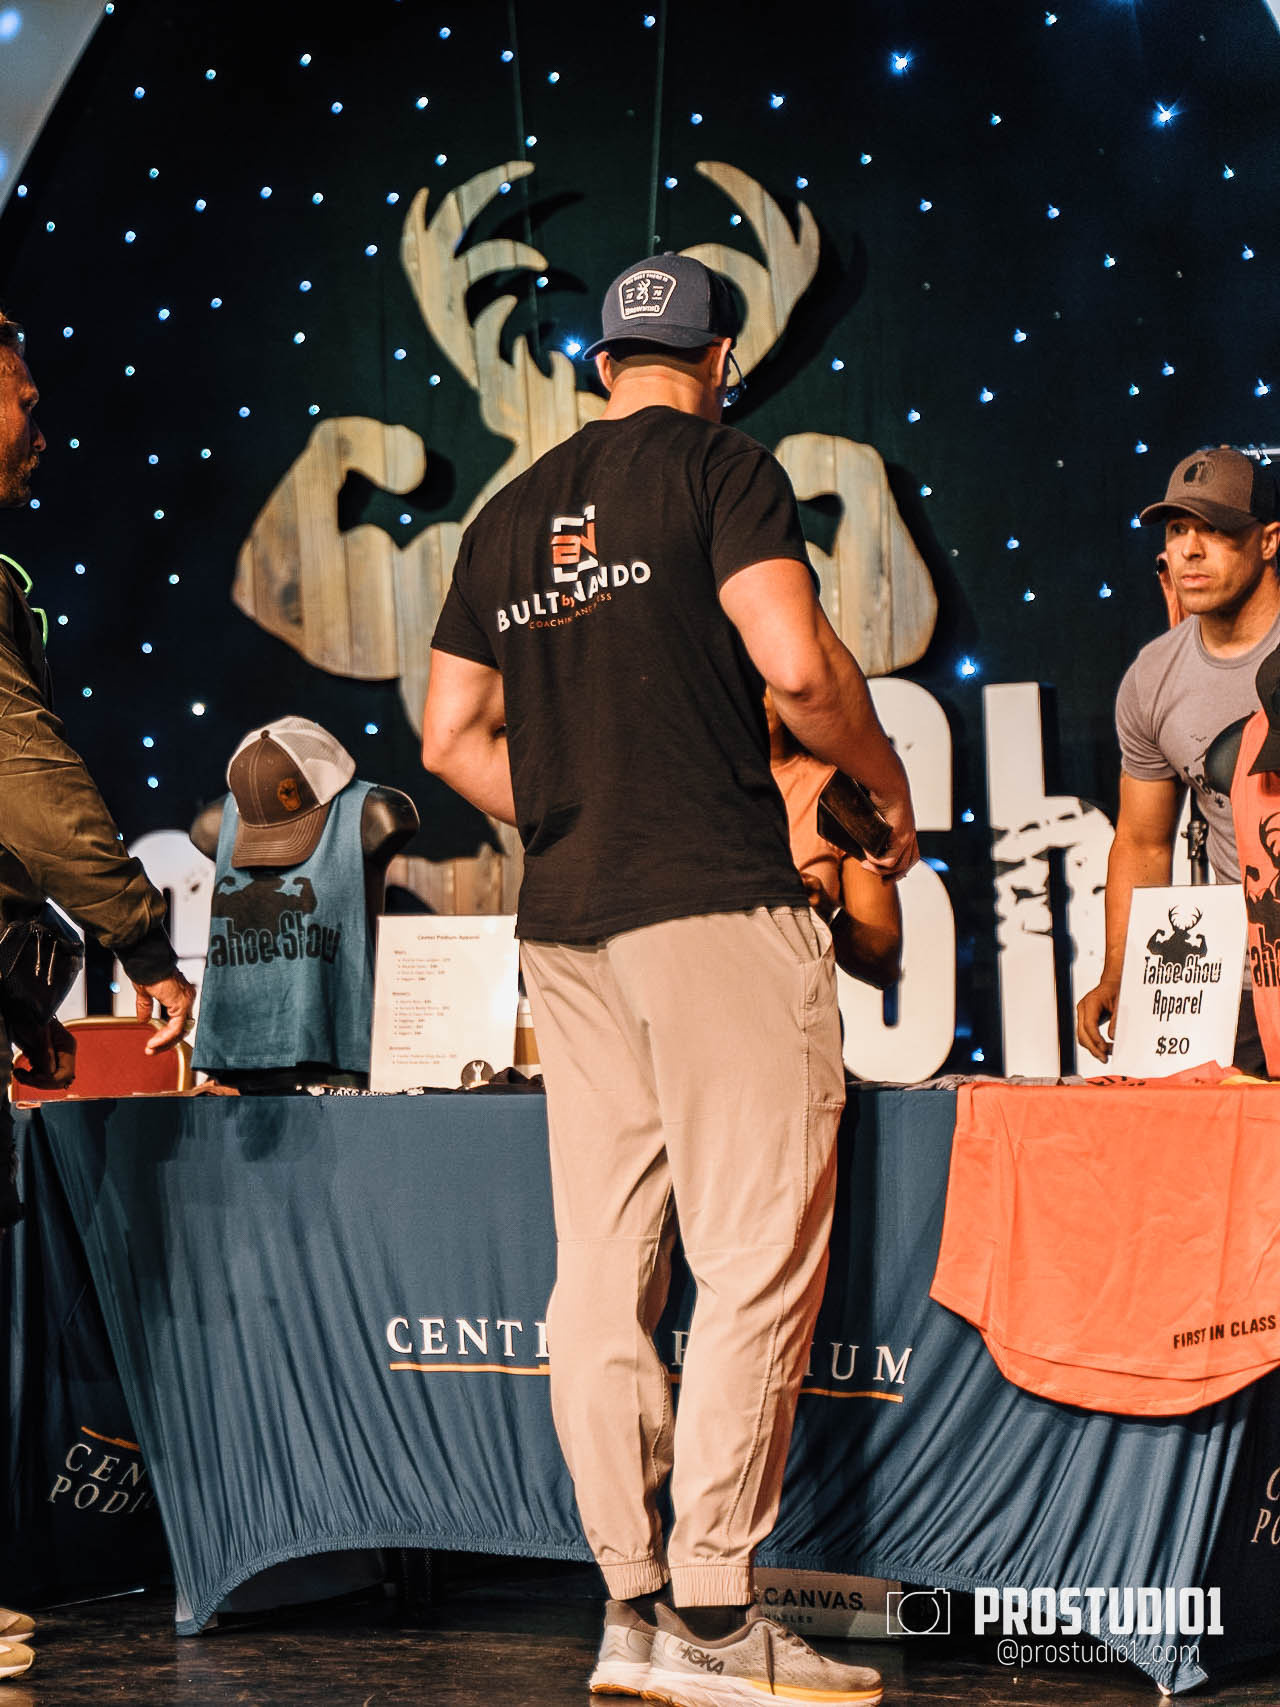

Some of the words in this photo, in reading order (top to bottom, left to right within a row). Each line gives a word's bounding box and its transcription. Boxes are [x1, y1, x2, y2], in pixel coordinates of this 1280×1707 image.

[528, 615, 574, 631] COACHI
[208, 918, 275, 968] ahoe
[1143, 956, 1183, 985] Tahoe
[1184, 954, 1222, 985] Show
[1152, 989, 1203, 1022] Apparel
[1155, 1036, 1190, 1057] $20
[385, 1316, 550, 1358] CENT
[1173, 1327, 1207, 1350] FIRST
[1210, 1323, 1225, 1341] IN
[1230, 1314, 1277, 1338] CLASS
[64, 1442, 148, 1488] CEN
[47, 1473, 150, 1515] PODI
